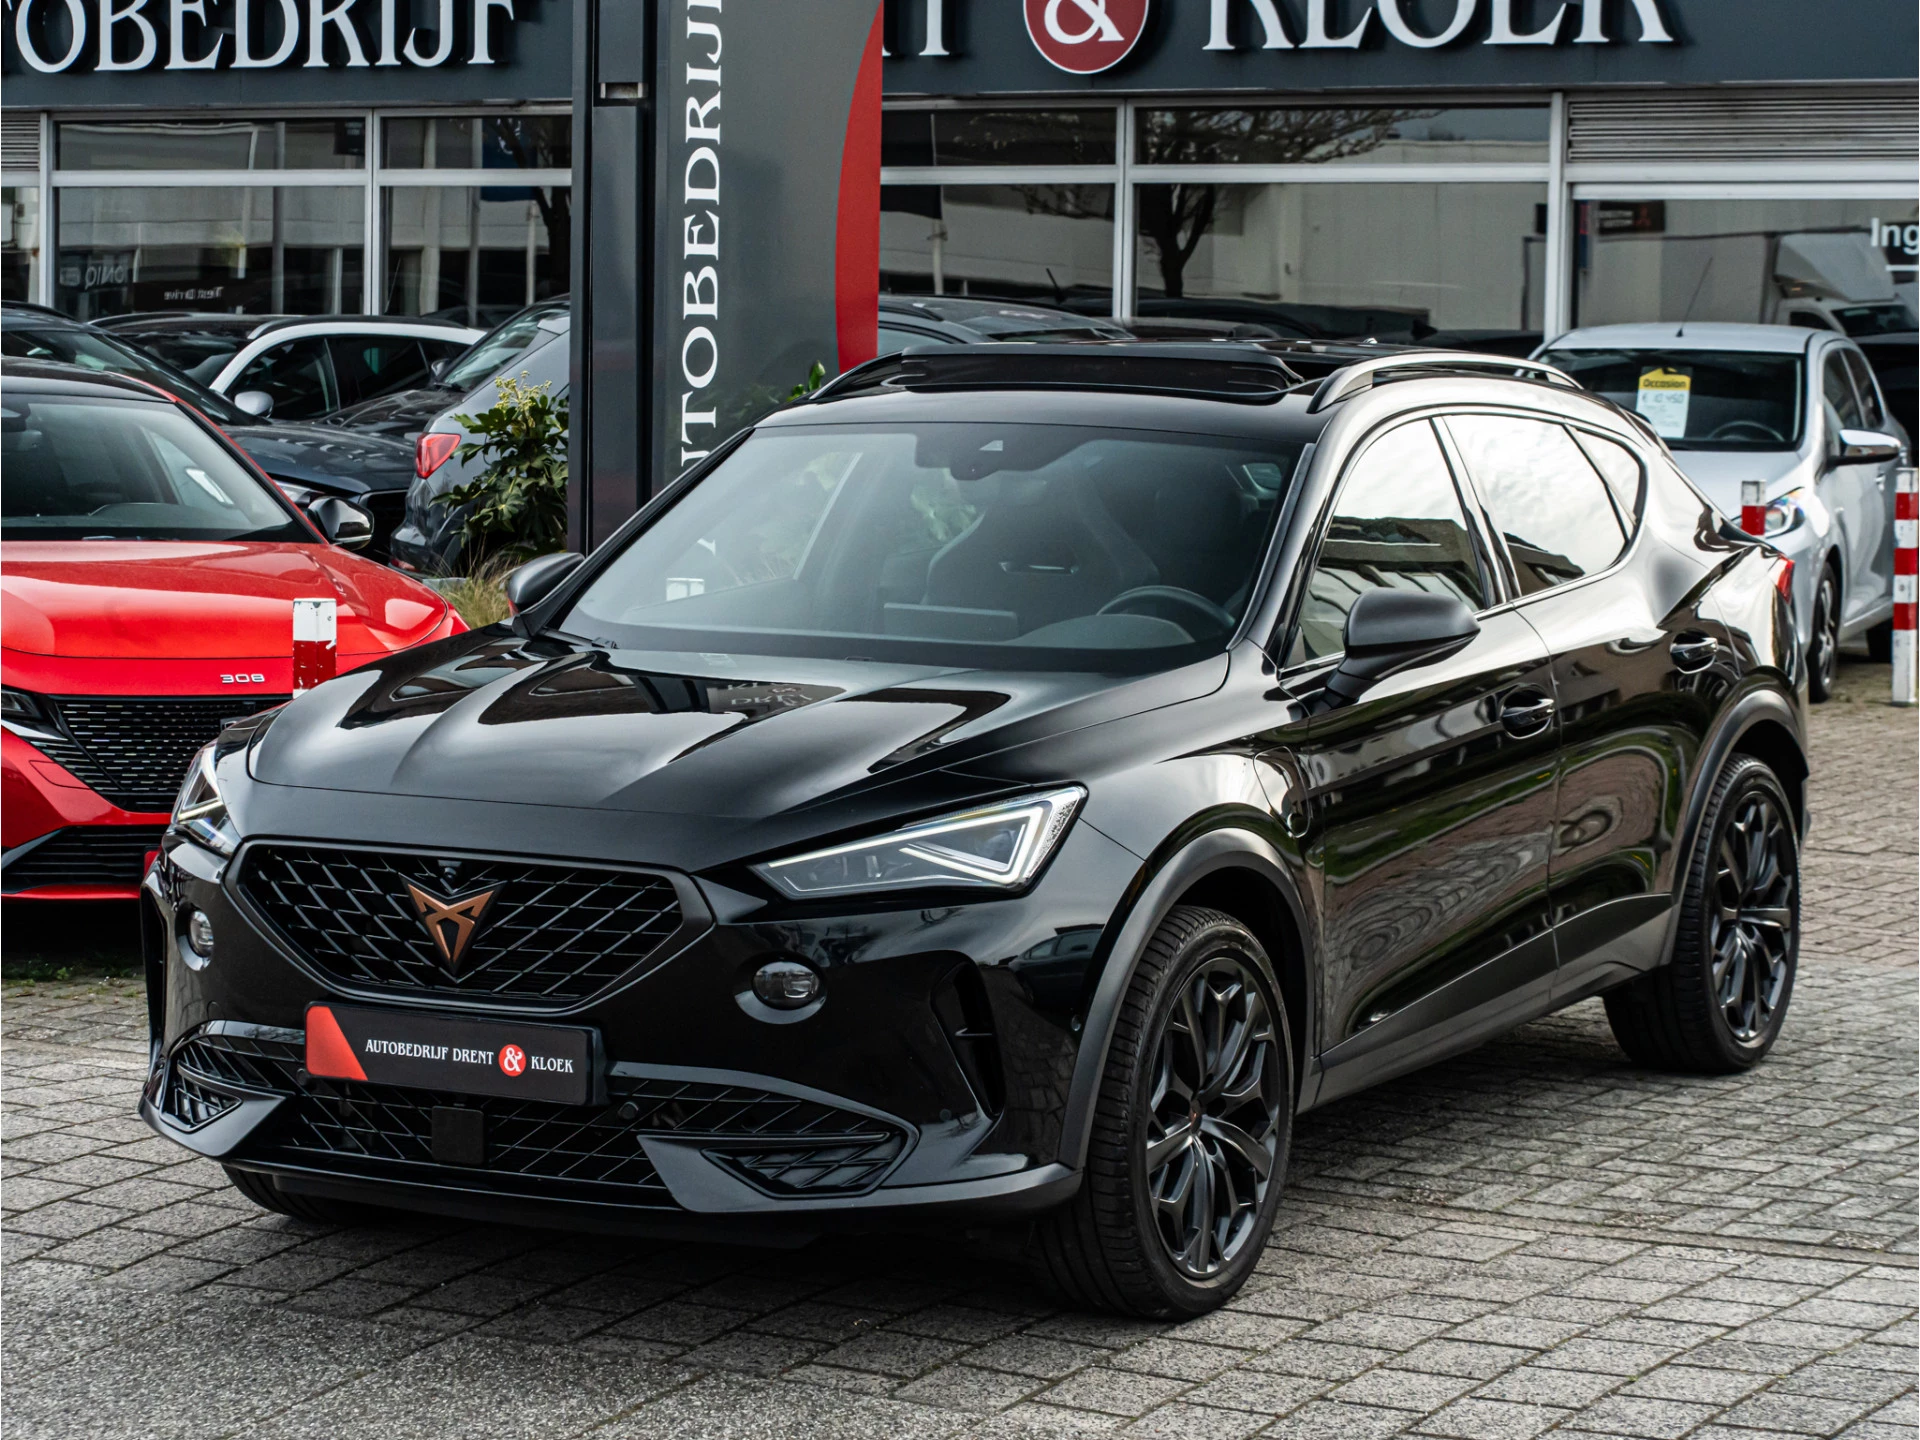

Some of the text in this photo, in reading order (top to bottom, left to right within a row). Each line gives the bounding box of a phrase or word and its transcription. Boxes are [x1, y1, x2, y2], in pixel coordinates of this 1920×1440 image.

[5, 0, 515, 73] OBEDRIJF
[681, 0, 723, 467] TOBEDRIJ
[220, 673, 265, 683] 308
[365, 1039, 574, 1073] AUTOBEDRIJF DRENT & KLOEK
